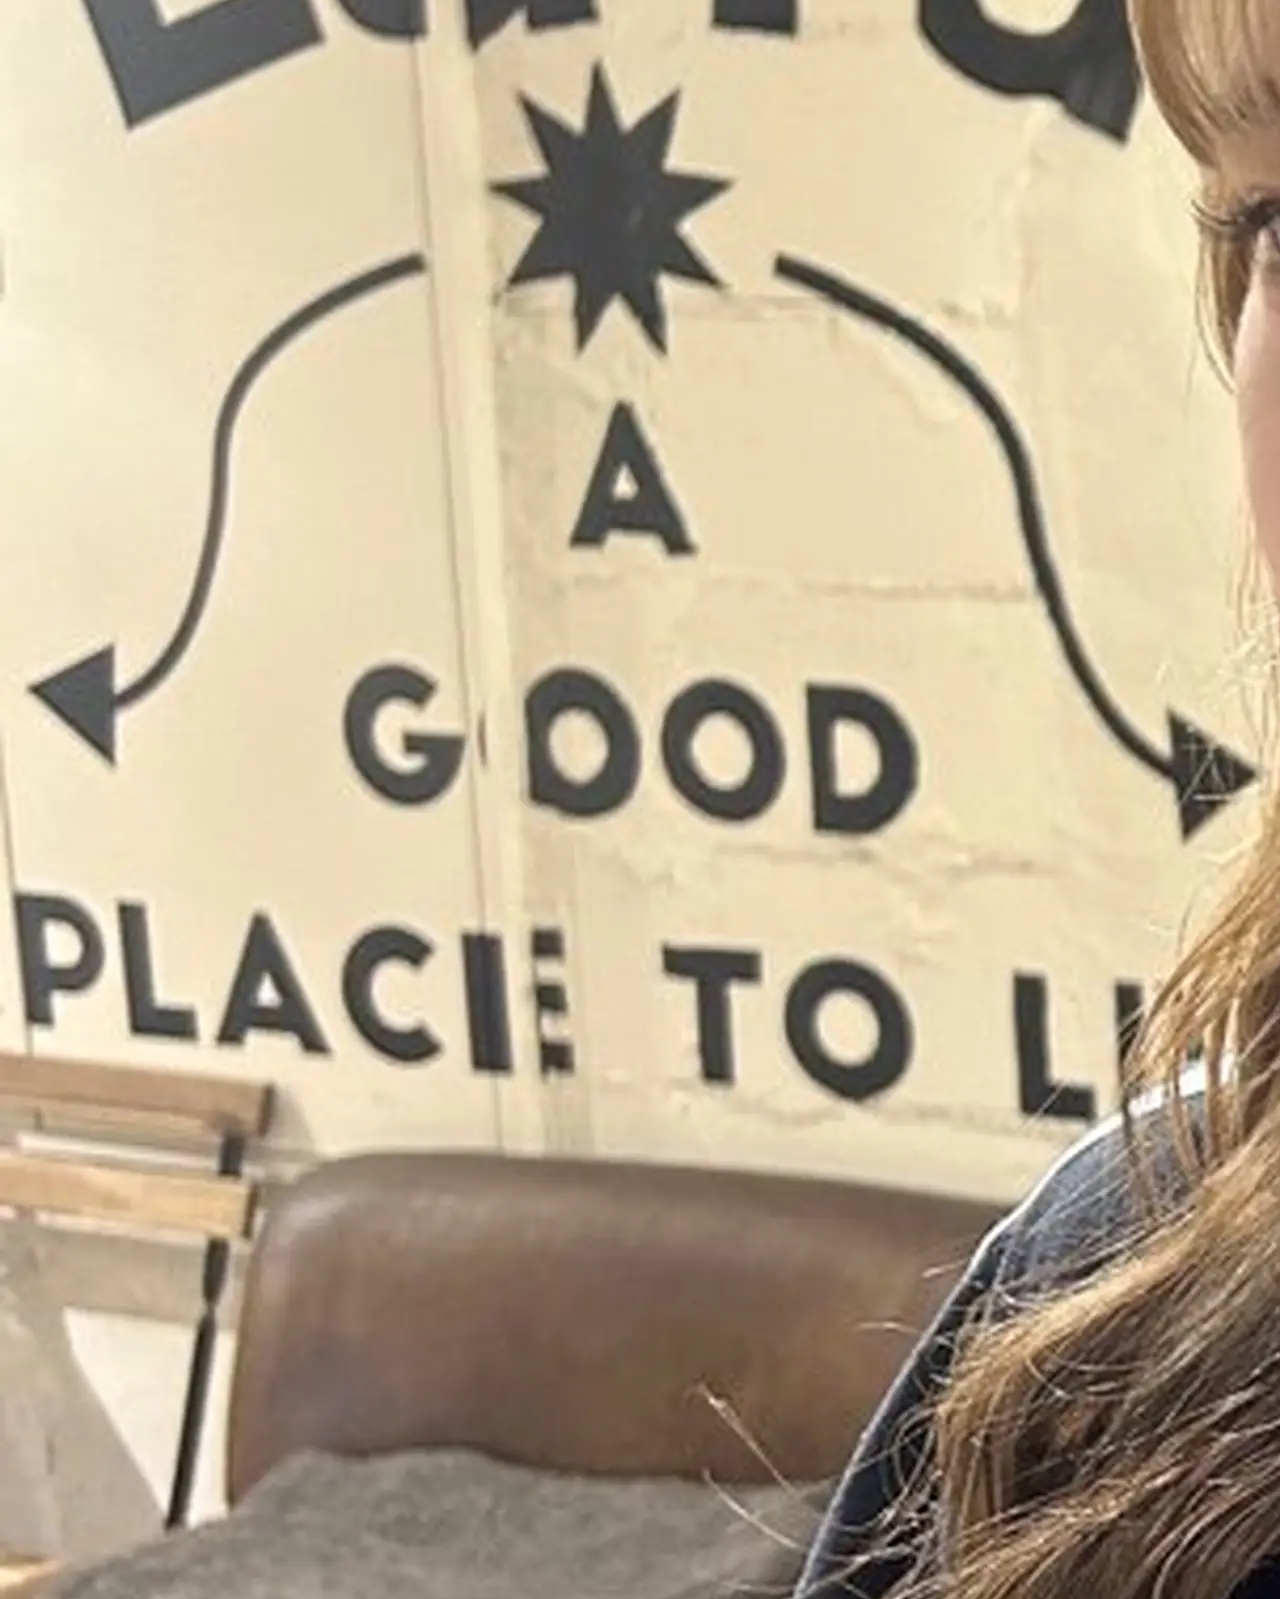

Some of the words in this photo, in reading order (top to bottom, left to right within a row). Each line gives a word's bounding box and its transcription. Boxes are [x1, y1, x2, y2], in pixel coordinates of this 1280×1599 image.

[569, 401, 696, 557] A
[343, 664, 919, 836] GOOD
[13, 892, 575, 1076] PLACE
[661, 943, 914, 1103] TO
